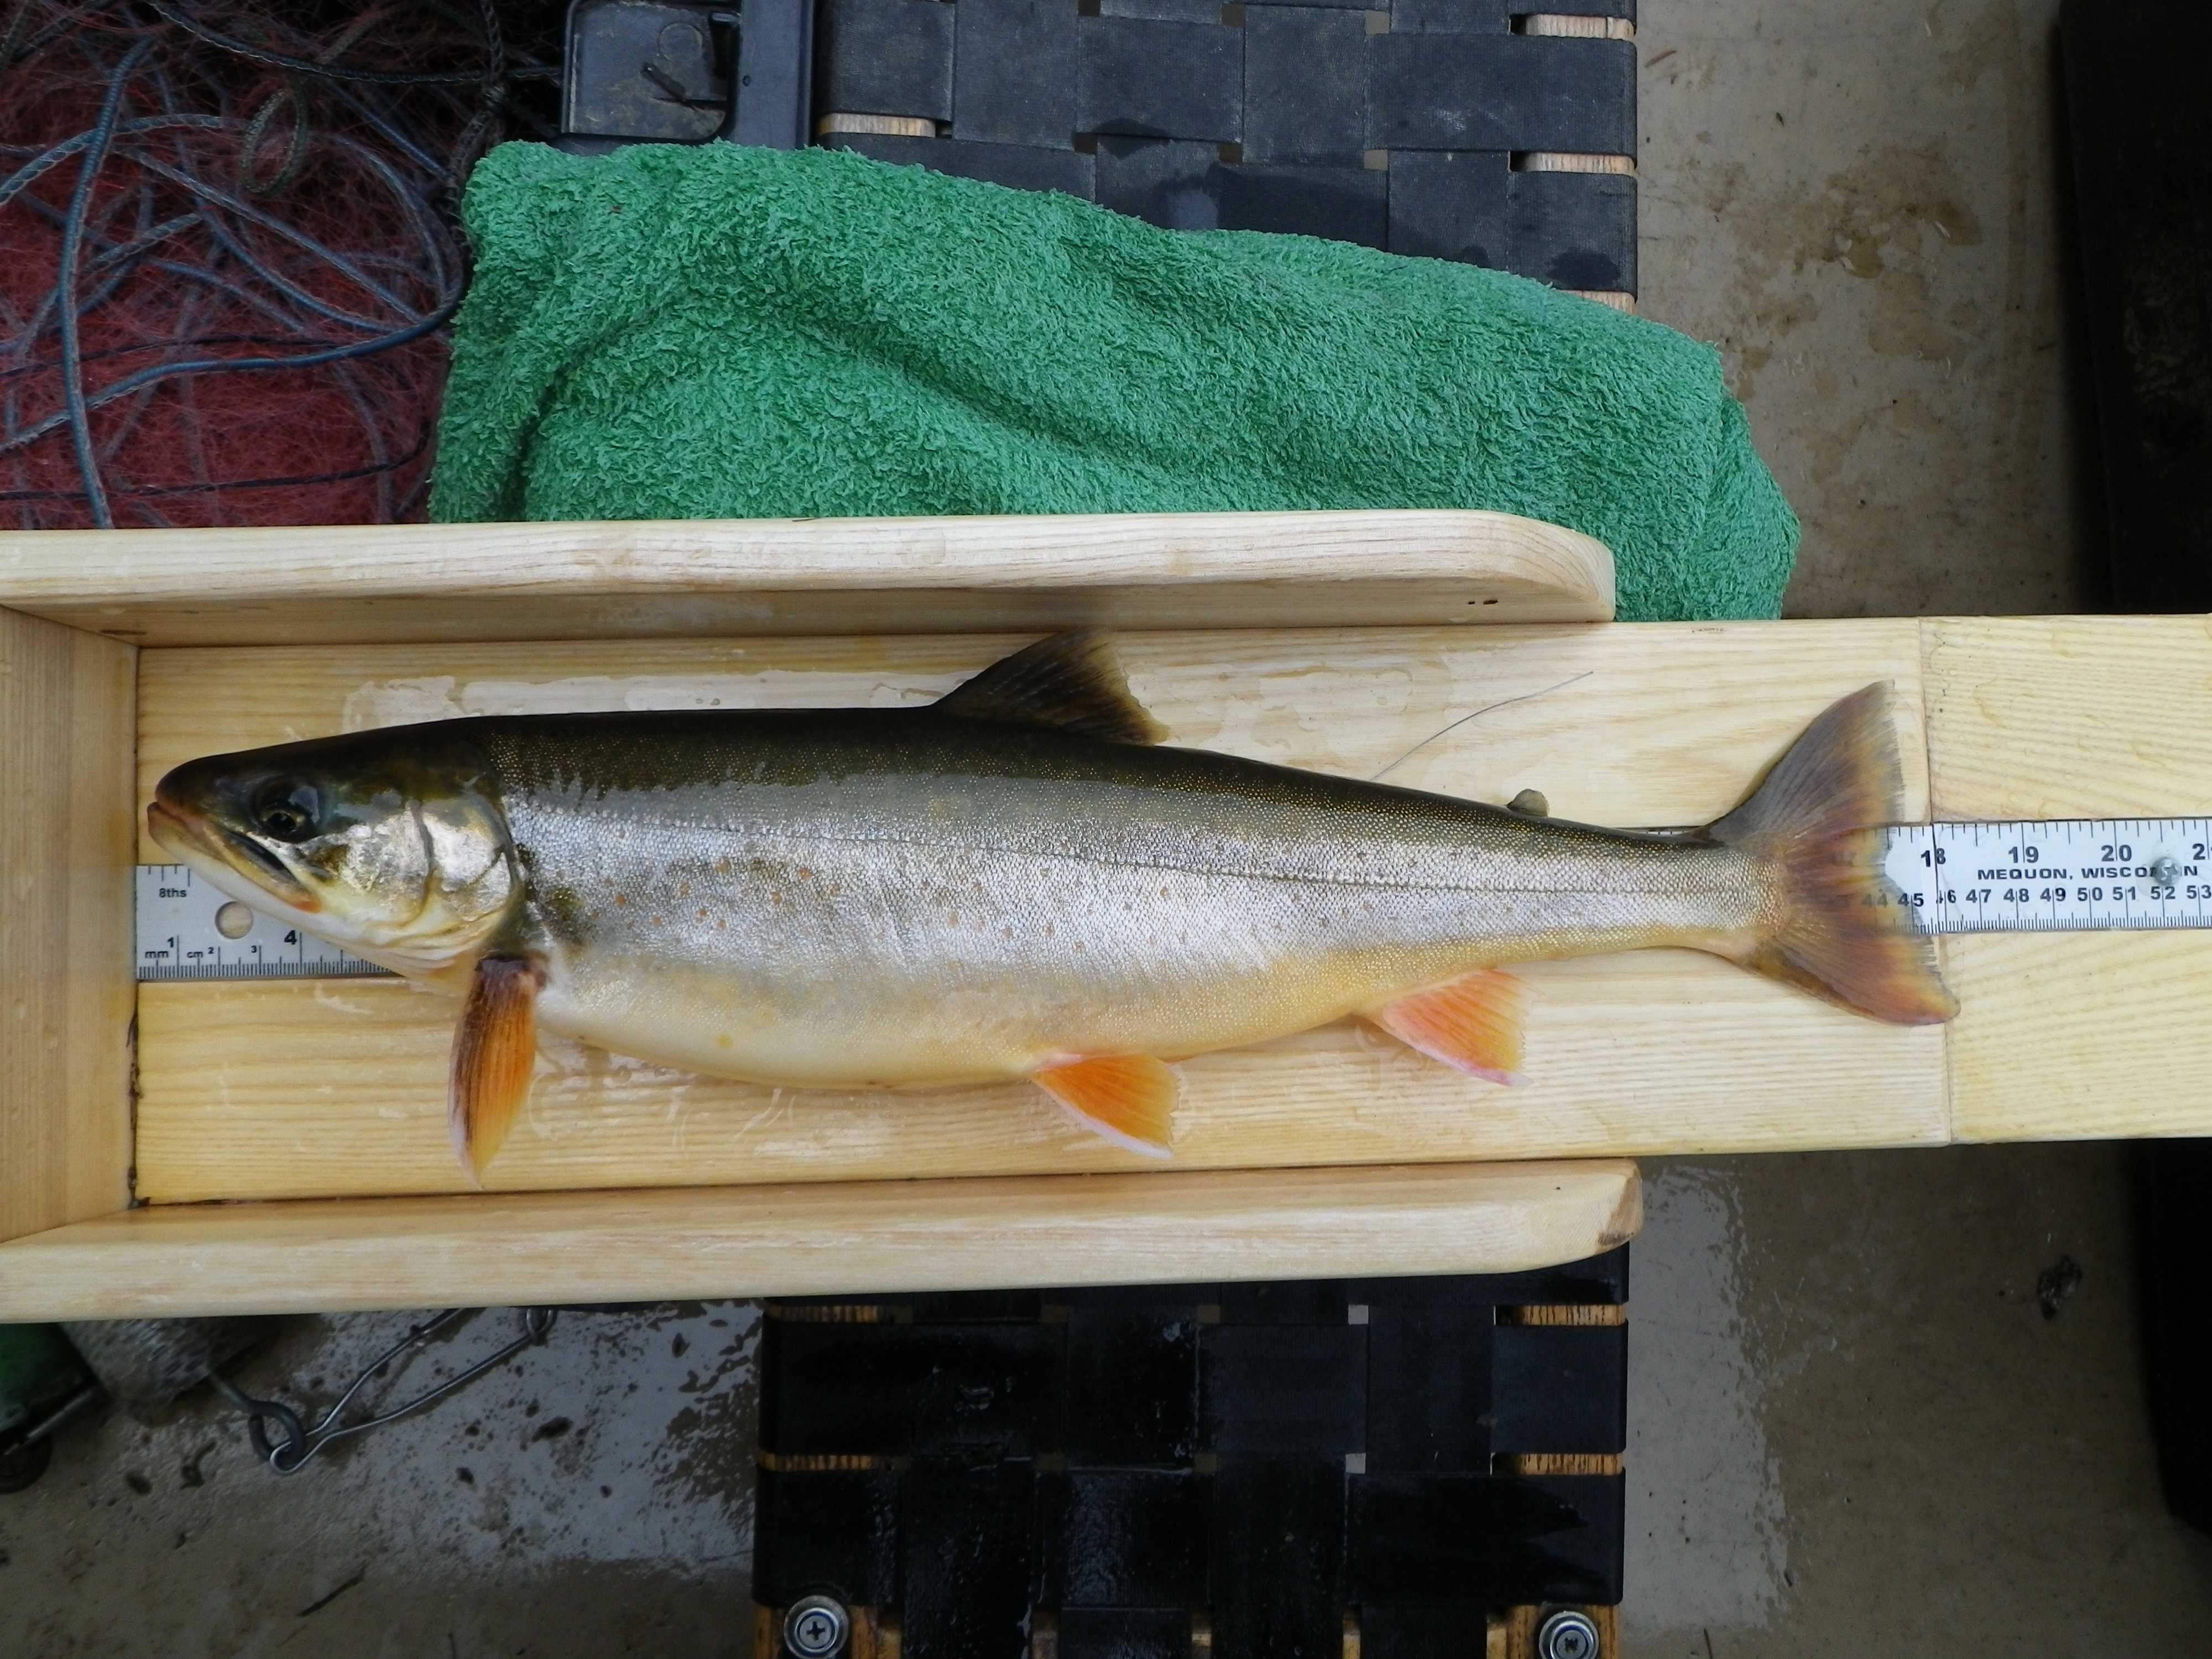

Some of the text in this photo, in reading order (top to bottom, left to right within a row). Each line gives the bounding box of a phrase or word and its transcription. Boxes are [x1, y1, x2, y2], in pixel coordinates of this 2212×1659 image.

[1921, 843, 2212, 867] 18 19 20 2
[1978, 866, 2197, 880] MEQUON, WISCON
[159, 888, 186, 898] 8ths
[1897, 893, 1924, 907] 45
[1965, 889, 1991, 903] 47
[2003, 888, 2029, 902] 48
[2040, 887, 2066, 902] 49
[2078, 886, 2103, 901] 50
[2112, 886, 2136, 901] 51
[2151, 886, 2176, 900] 52
[2187, 885, 2212, 899] 53
[144, 950, 169, 958] mm
[167, 937, 174, 948] 1
[187, 950, 204, 958] cm
[251, 945, 257, 953] 3
[284, 930, 298, 945] 4
